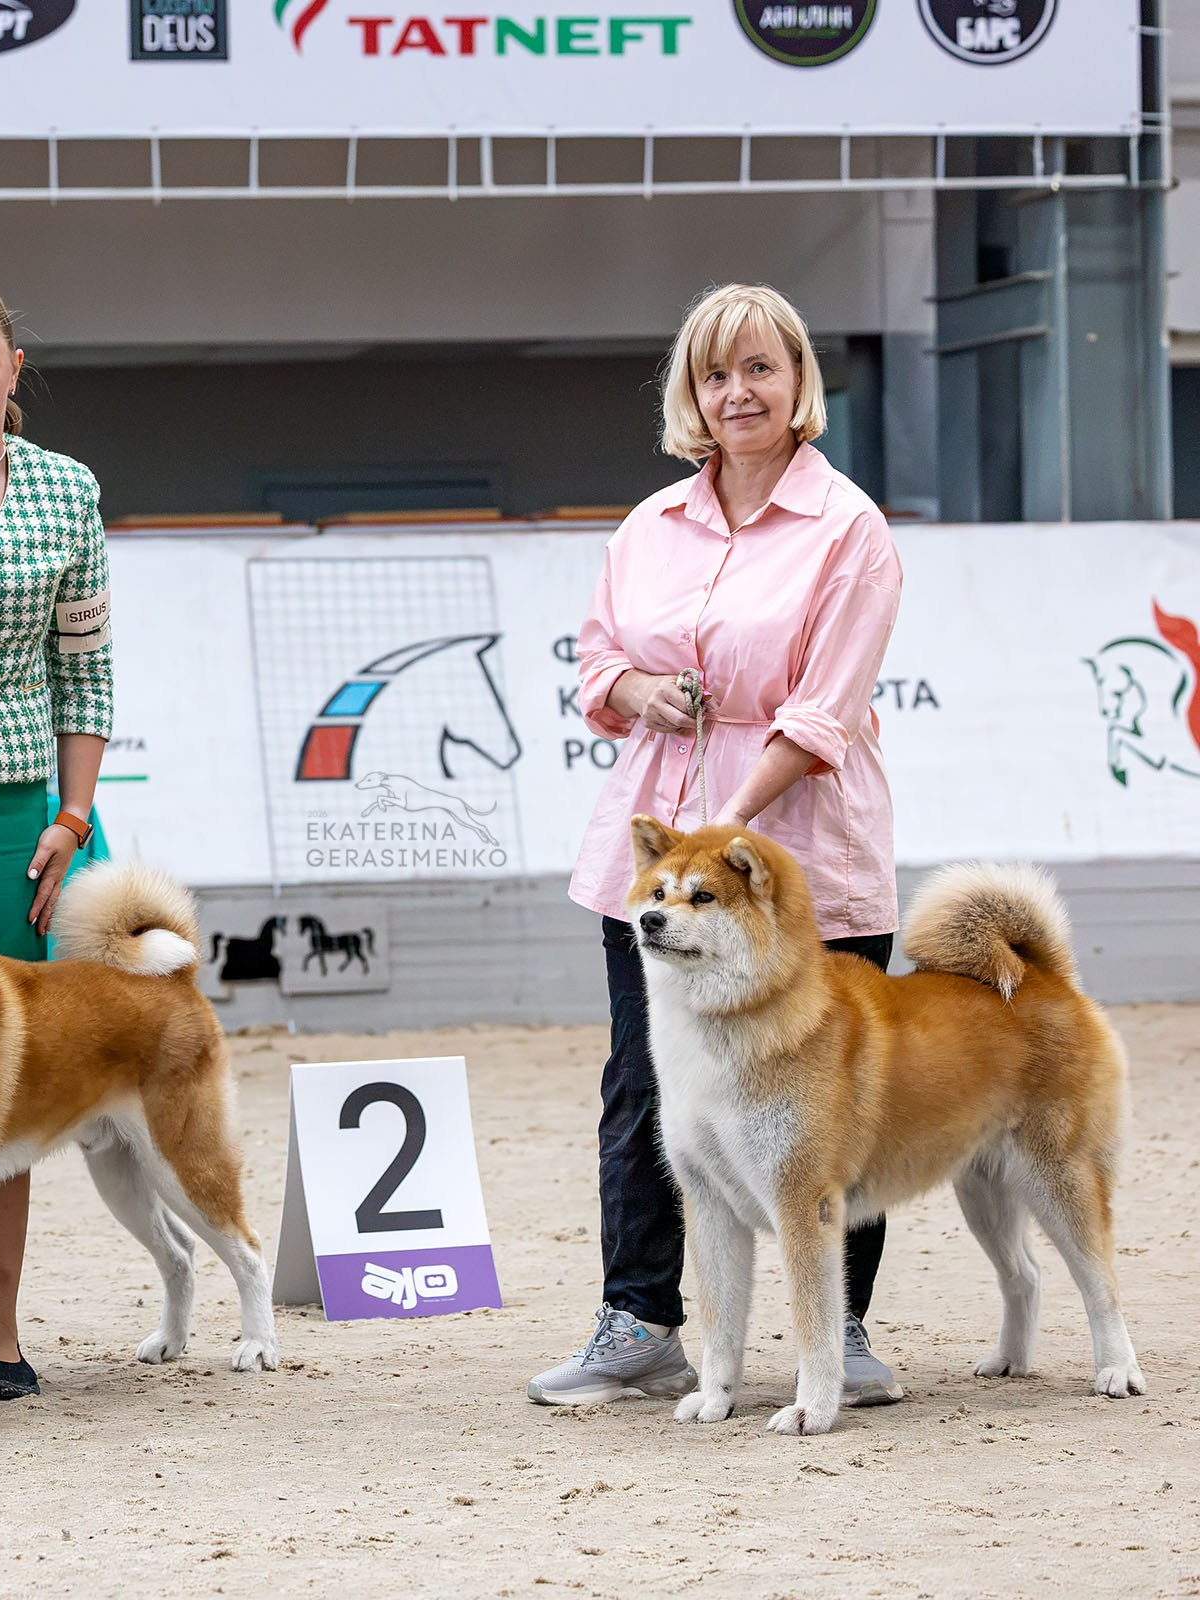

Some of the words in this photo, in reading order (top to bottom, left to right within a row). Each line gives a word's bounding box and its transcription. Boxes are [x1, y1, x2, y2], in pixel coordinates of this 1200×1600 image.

[141, 14, 216, 52] DEUS
[347, 17, 693, 55] TATNEFT
[956, 17, 1021, 51] БАРС
[68, 601, 107, 623] SIRIUS
[871, 678, 940, 710] РТА
[563, 738, 618, 770] РО
[339, 1081, 445, 1234] 2
